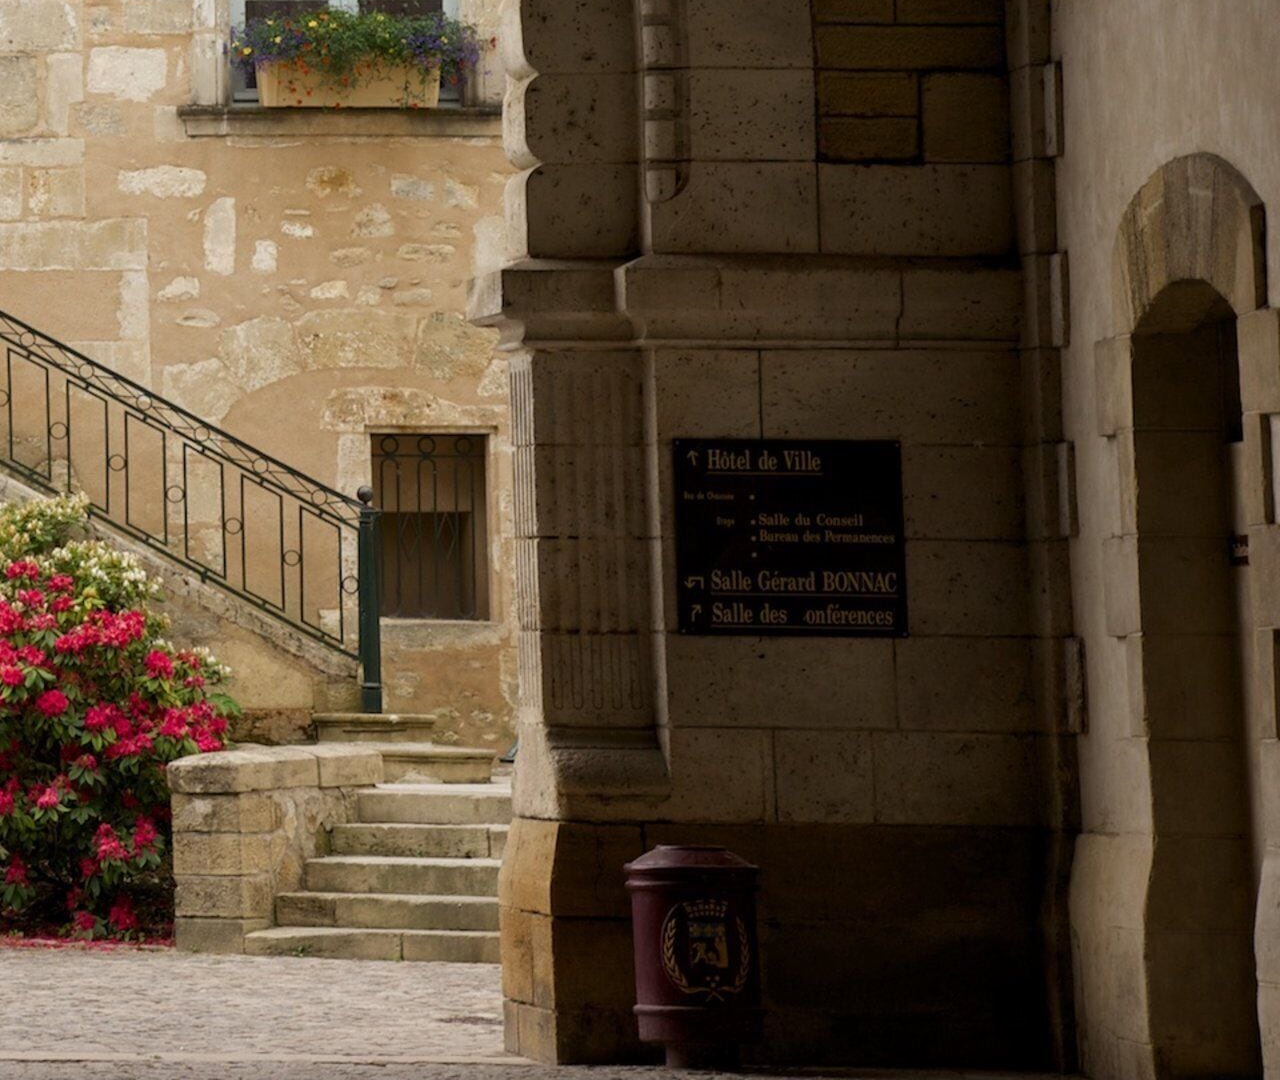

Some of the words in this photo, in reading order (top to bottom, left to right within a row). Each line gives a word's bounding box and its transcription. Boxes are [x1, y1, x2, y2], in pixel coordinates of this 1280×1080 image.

[707, 450, 750, 470] Hôtel
[758, 450, 777, 470] de
[783, 451, 821, 471] Ville
[758, 513, 790, 527] Salle
[795, 513, 811, 526] du
[816, 514, 863, 527] Conseil
[759, 530, 799, 544] Bureau
[803, 530, 821, 543] des
[825, 531, 895, 545] Permanences
[711, 570, 752, 591] Salle
[758, 570, 816, 592] Gérard
[823, 572, 897, 593] BONNAC
[712, 602, 753, 623] Salle
[760, 602, 788, 624] des
[801, 603, 894, 625] onférences
